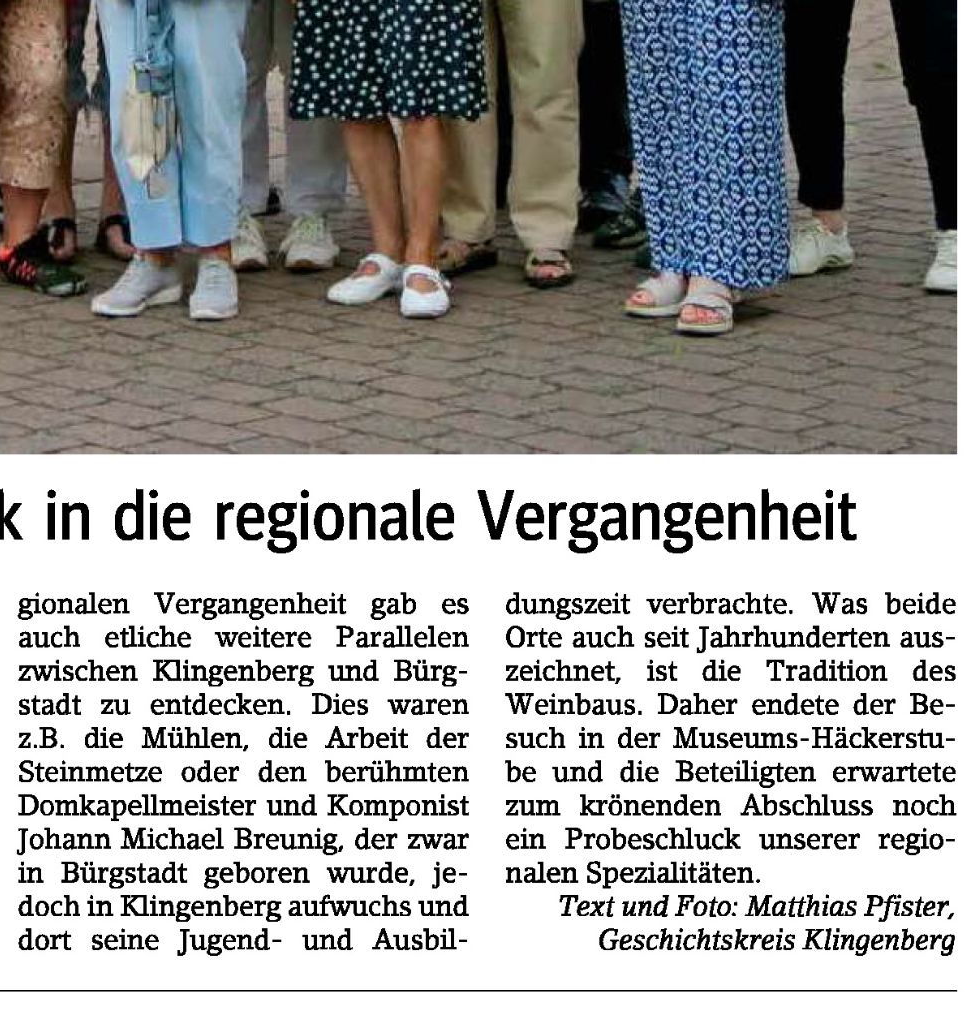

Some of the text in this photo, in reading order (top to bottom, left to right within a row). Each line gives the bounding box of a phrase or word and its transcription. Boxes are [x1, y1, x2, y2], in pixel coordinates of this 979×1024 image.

[48, 489, 89, 540] in
[115, 488, 191, 540] die
[217, 488, 454, 553] regionale
[478, 489, 857, 553] Vergangenheit
[18, 592, 469, 620] gionalen Vergangenheit gab es
[506, 592, 956, 620] dungszeit verbrachte. Was beide
[506, 625, 955, 653] Orte auch seit Jahrhunderten aus-
[18, 660, 467, 687] zwischen Klingenberg und Bürg-
[506, 660, 956, 684] zeichnet, ist die Tradition des
[19, 693, 469, 715] stadt zu entdecken. Dies waren
[506, 727, 955, 748] such in der Museums-Häckerstu-
[19, 760, 469, 782] Steinmetze oder den berühmten
[505, 760, 956, 788] be und die Beteiligten erwartete
[18, 794, 469, 821] Domkapellmeister und Komponist
[506, 793, 957, 816] zum krönenden Abschluss noch
[17, 828, 469, 855] Johann Michael Breunig, der zwar
[18, 862, 467, 889] in Bürgstadt geboren wurde, je-
[506, 861, 760, 889] nalen Spezialitäten.
[560, 894, 954, 922] Text und Foto: Matthias Pfister,
[18, 928, 467, 956] dort seine Jugend- und Ausbil-
[599, 928, 955, 956] Geschichtskreis Klingenberg
